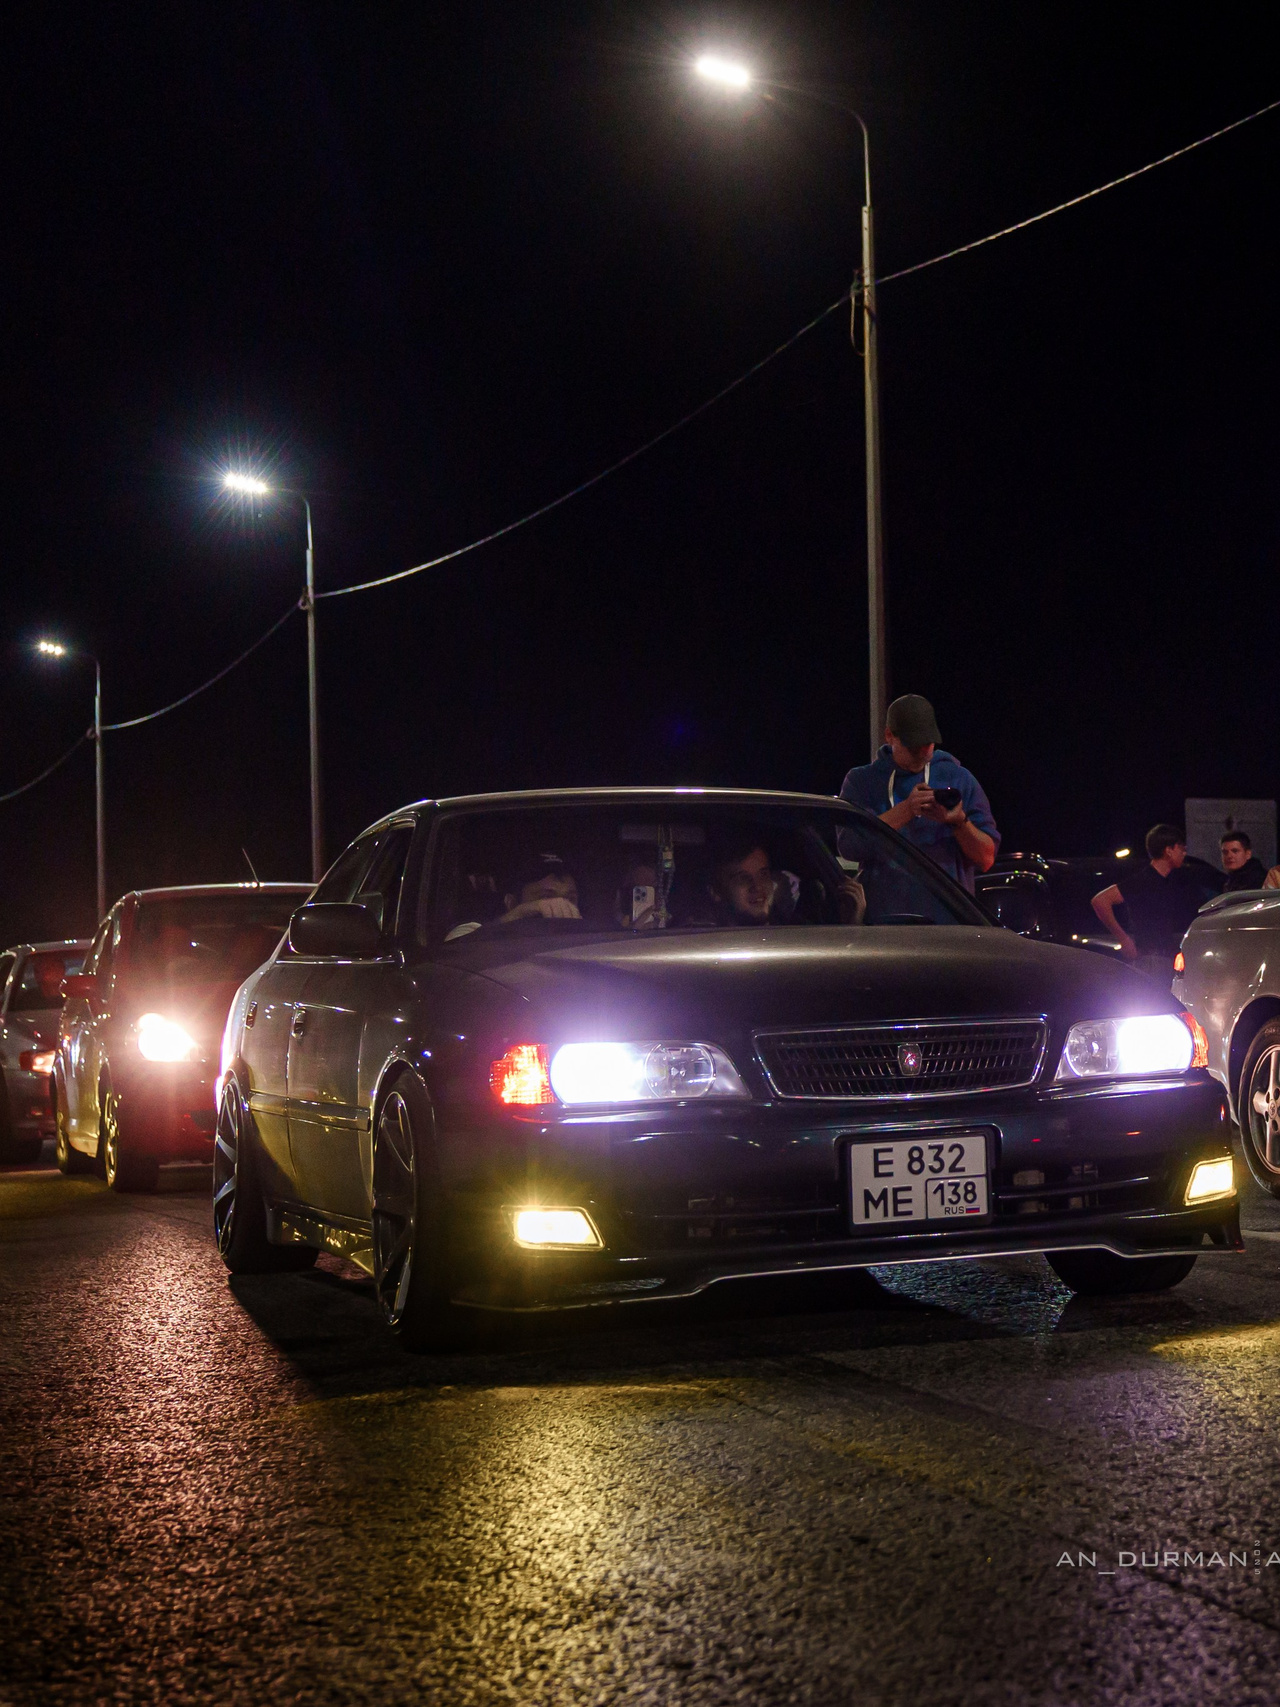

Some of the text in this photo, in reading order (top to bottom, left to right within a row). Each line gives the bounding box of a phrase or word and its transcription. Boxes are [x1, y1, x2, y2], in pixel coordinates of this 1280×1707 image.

[873, 1143, 966, 1178] E 832
[863, 1185, 913, 1219] ME
[932, 1181, 977, 1206] 138
[944, 1206, 964, 1215] RUS
